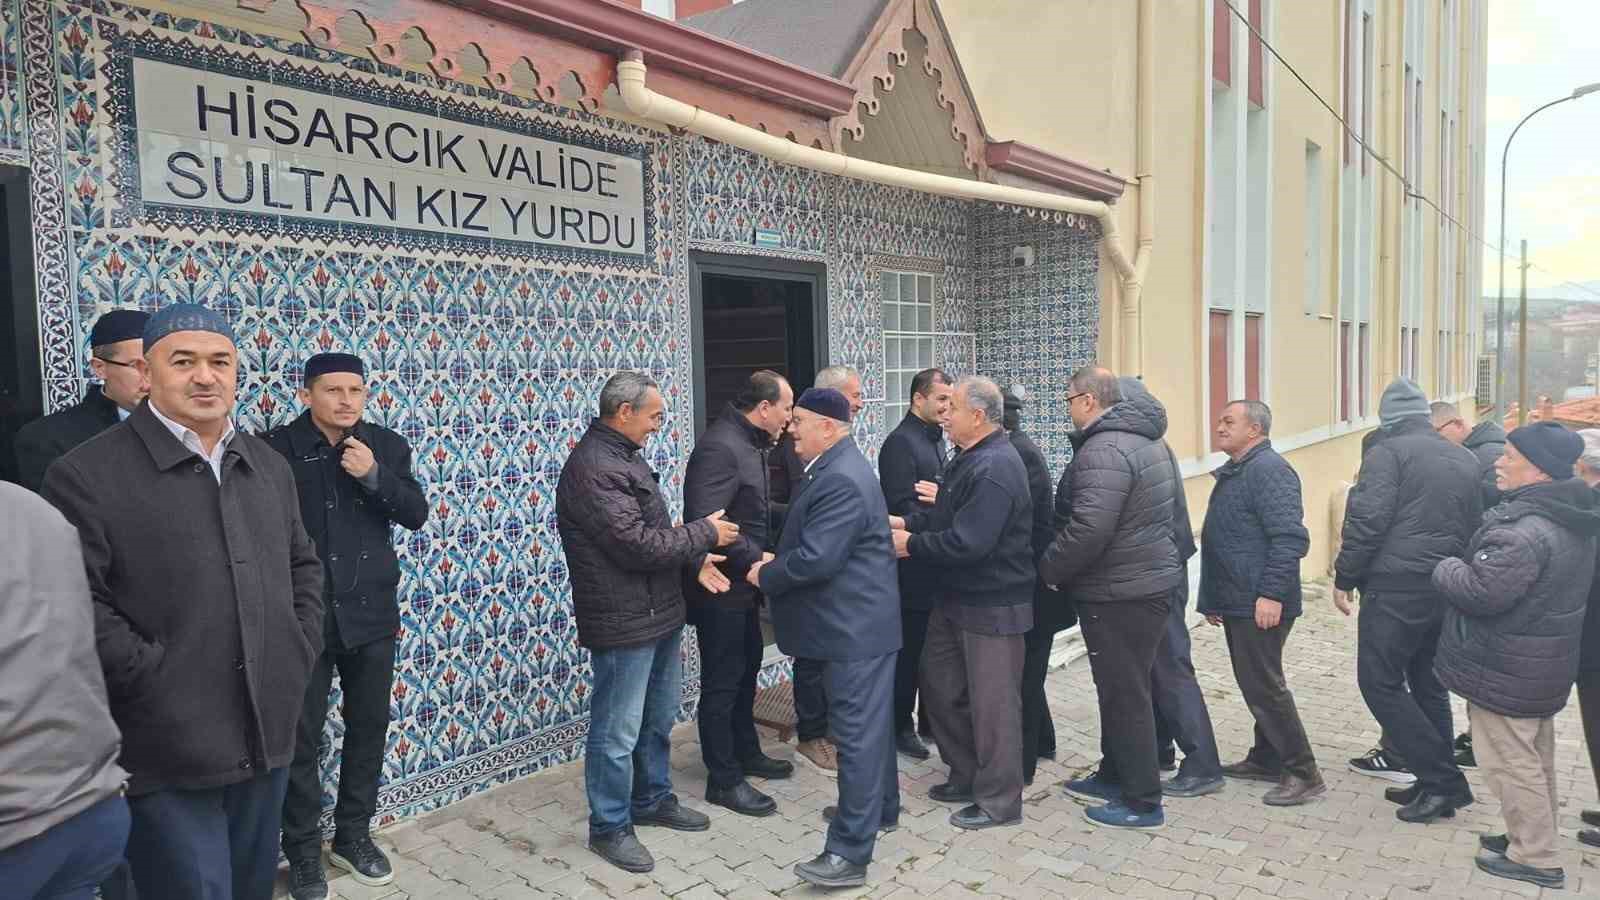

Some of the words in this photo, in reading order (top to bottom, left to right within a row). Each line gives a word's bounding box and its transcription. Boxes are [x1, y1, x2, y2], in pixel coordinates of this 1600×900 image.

[196, 84, 467, 174] HİSARCIK
[478, 138, 619, 199] VALİDE
[165, 151, 397, 221] SULTAN
[416, 185, 489, 232] KIZ
[500, 197, 636, 249] YURDU
